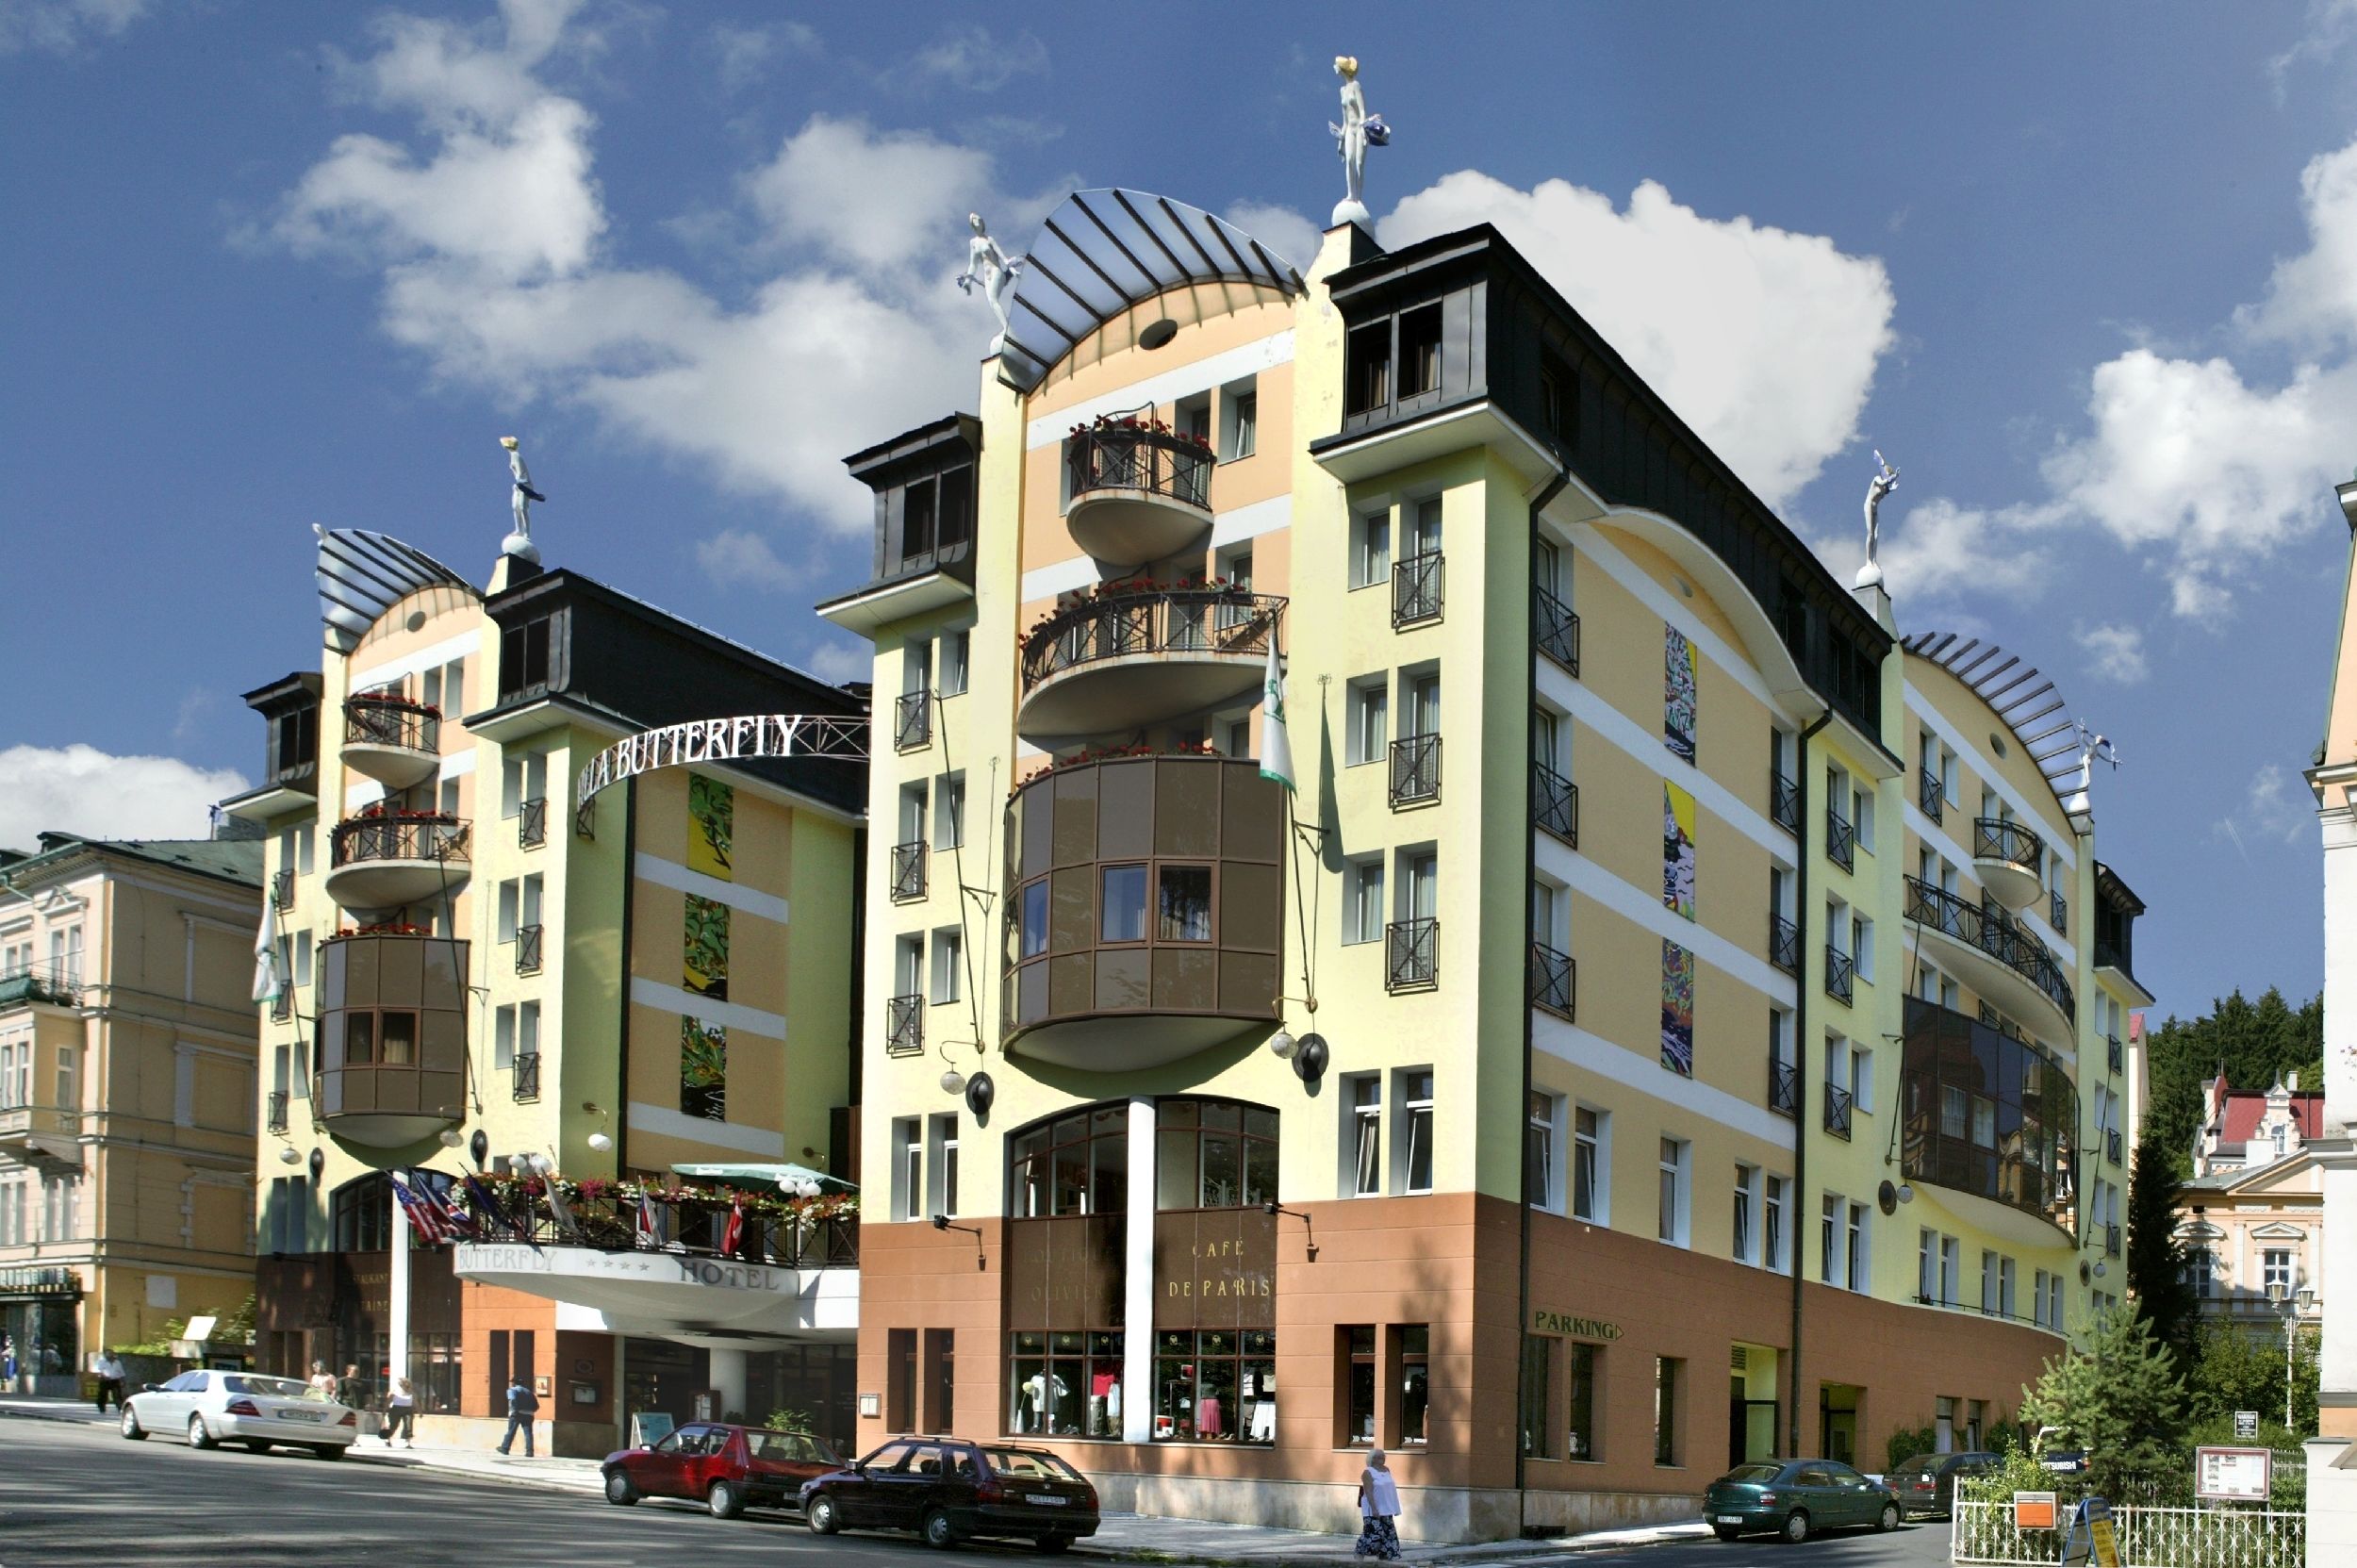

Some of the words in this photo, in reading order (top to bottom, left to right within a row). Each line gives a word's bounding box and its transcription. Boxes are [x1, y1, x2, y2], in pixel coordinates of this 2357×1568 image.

[616, 714, 803, 781] BUTTERFLY
[458, 1247, 558, 1272] BUTTERFLY
[1192, 1236, 1244, 1259] CAFÉ
[679, 1261, 781, 1291] HOTEL
[1169, 1280, 1192, 1297] DE
[1203, 1277, 1270, 1297] PARIS
[1534, 1310, 1615, 1340] PARKING
